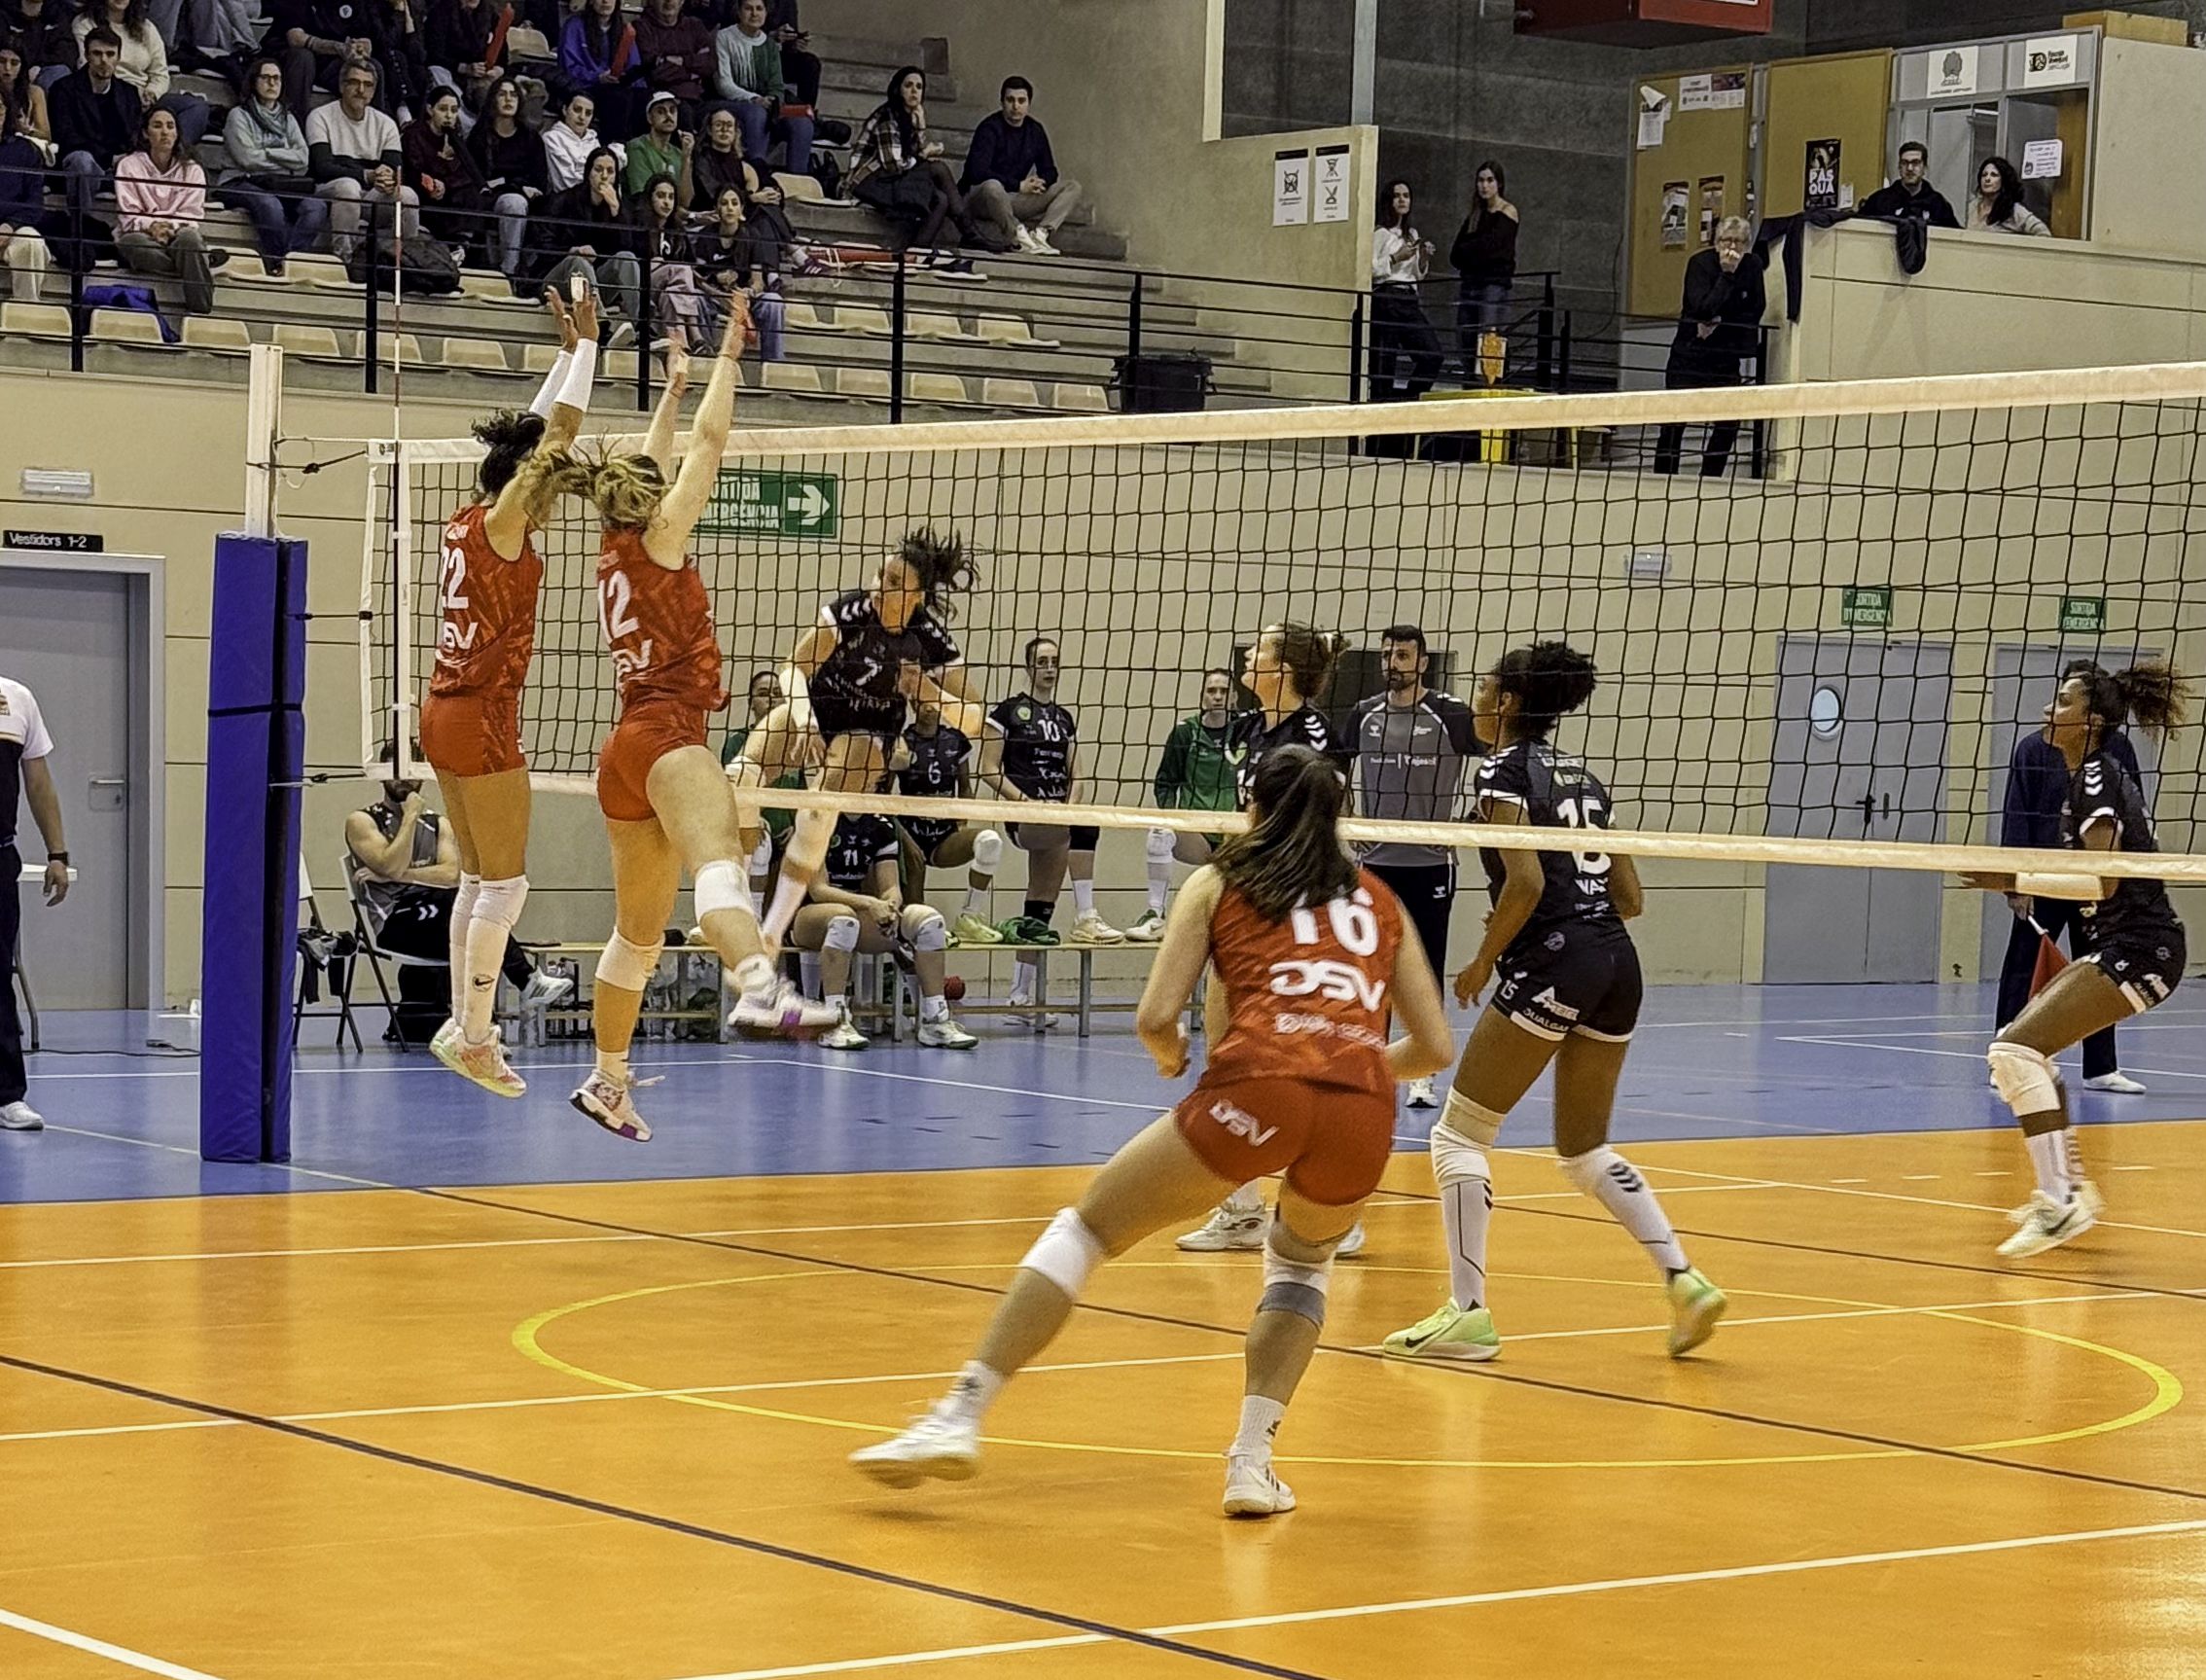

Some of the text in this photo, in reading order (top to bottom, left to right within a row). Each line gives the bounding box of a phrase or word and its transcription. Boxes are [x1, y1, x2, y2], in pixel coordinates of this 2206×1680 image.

[1809, 168, 1834, 183] PAS
[1808, 182, 1834, 196] QUA
[710, 476, 761, 501] ORTIDA
[9, 532, 87, 548] Vestidors 1-2
[597, 570, 641, 644] 12
[1038, 719, 1061, 742] 10
[928, 761, 942, 785] 6
[1556, 798, 1612, 876] 15
[1291, 887, 1378, 957] 16
[1500, 979, 1519, 1000] 15
